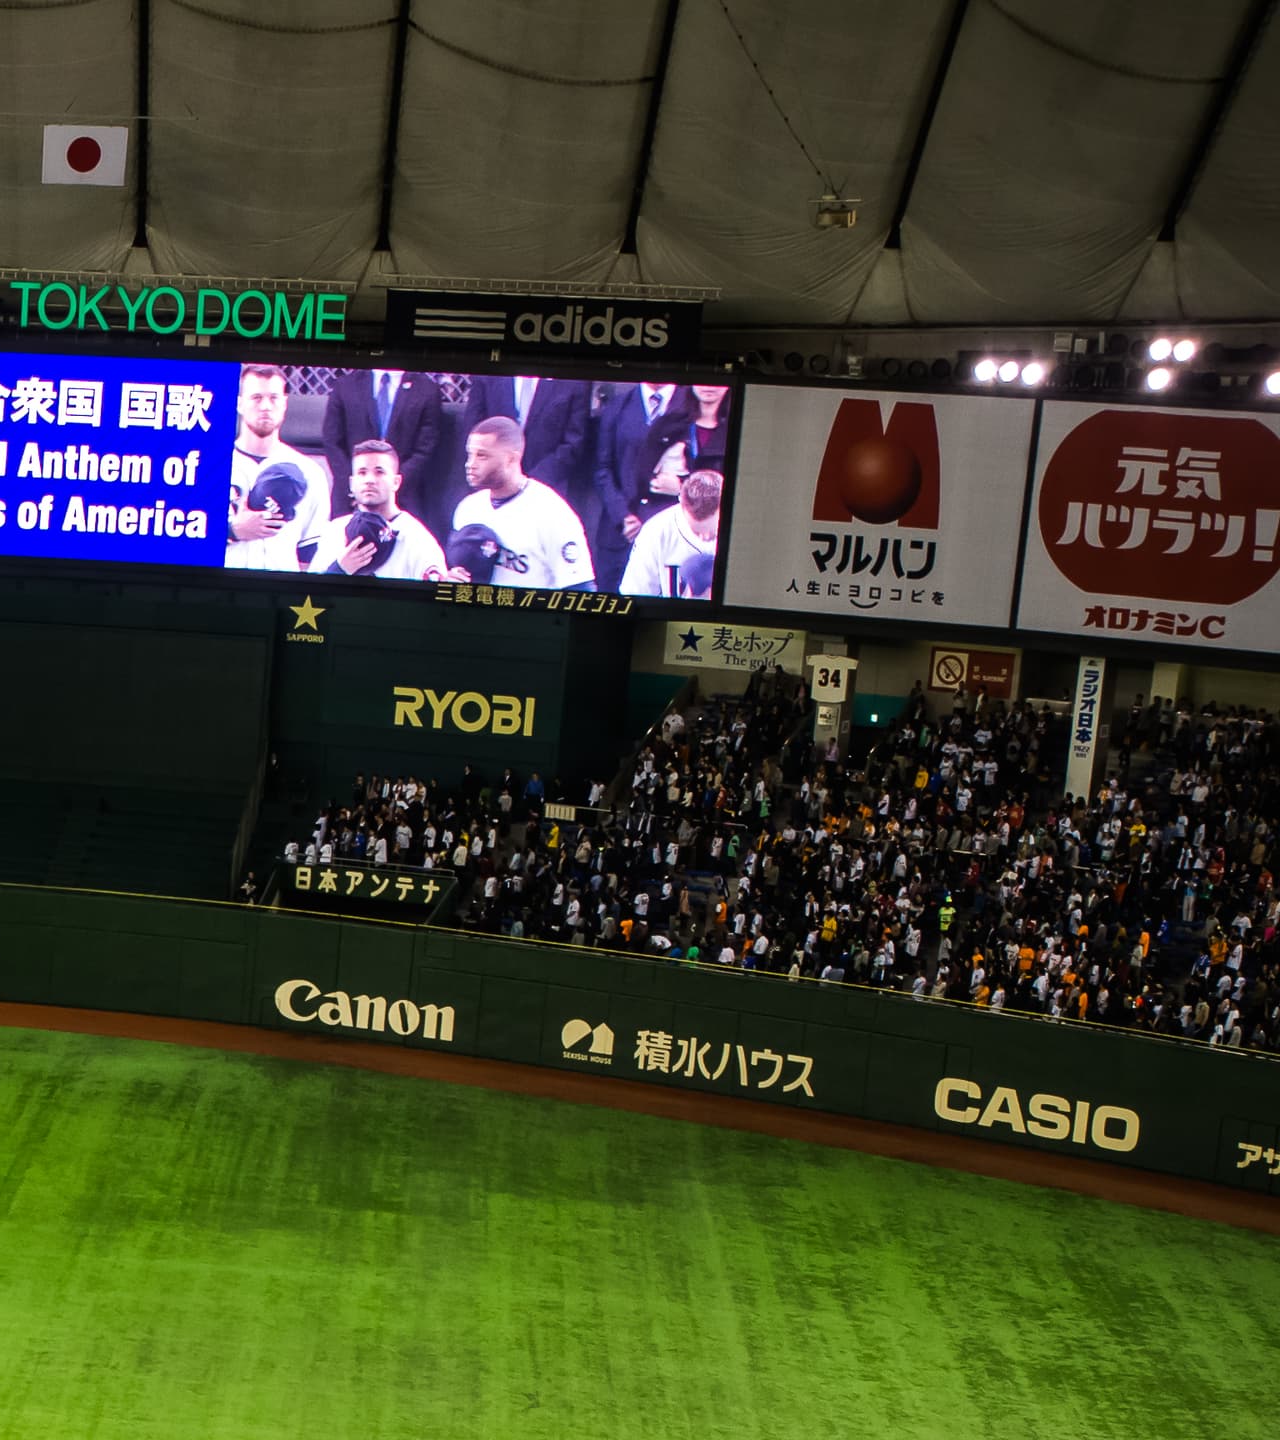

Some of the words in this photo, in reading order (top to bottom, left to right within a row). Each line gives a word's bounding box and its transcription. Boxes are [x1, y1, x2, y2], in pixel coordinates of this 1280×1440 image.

[10, 282, 185, 335] TOKYO
[194, 289, 348, 342] DOME
[513, 305, 670, 349] adidas
[118, 385, 213, 432] 国歌
[18, 444, 152, 484] Anthem
[163, 450, 201, 487] of
[1115, 447, 1221, 500] 元気
[17, 495, 54, 532] of
[62, 497, 208, 539] America
[809, 532, 936, 580] マルハン
[435, 583, 515, 608] 三菱電機
[519, 590, 633, 615] オーロラビジョン
[786, 578, 945, 606] 人生にヨロコビを
[286, 632, 324, 644] SAPPORO
[712, 626, 794, 656] 麦とホップ
[1083, 605, 1227, 640] オロナミンC
[724, 653, 746, 666] The
[818, 668, 840, 688] 34
[393, 686, 536, 738] RYOBI
[1076, 669, 1099, 743] ラジオ日本
[295, 867, 441, 904] 日本アンテナ
[274, 979, 456, 1042] Canon
[562, 1051, 588, 1061] SEKISUI
[590, 1054, 612, 1065] HOUSE
[634, 1029, 814, 1097] 積水ハウス
[934, 1077, 1140, 1153] CASIO
